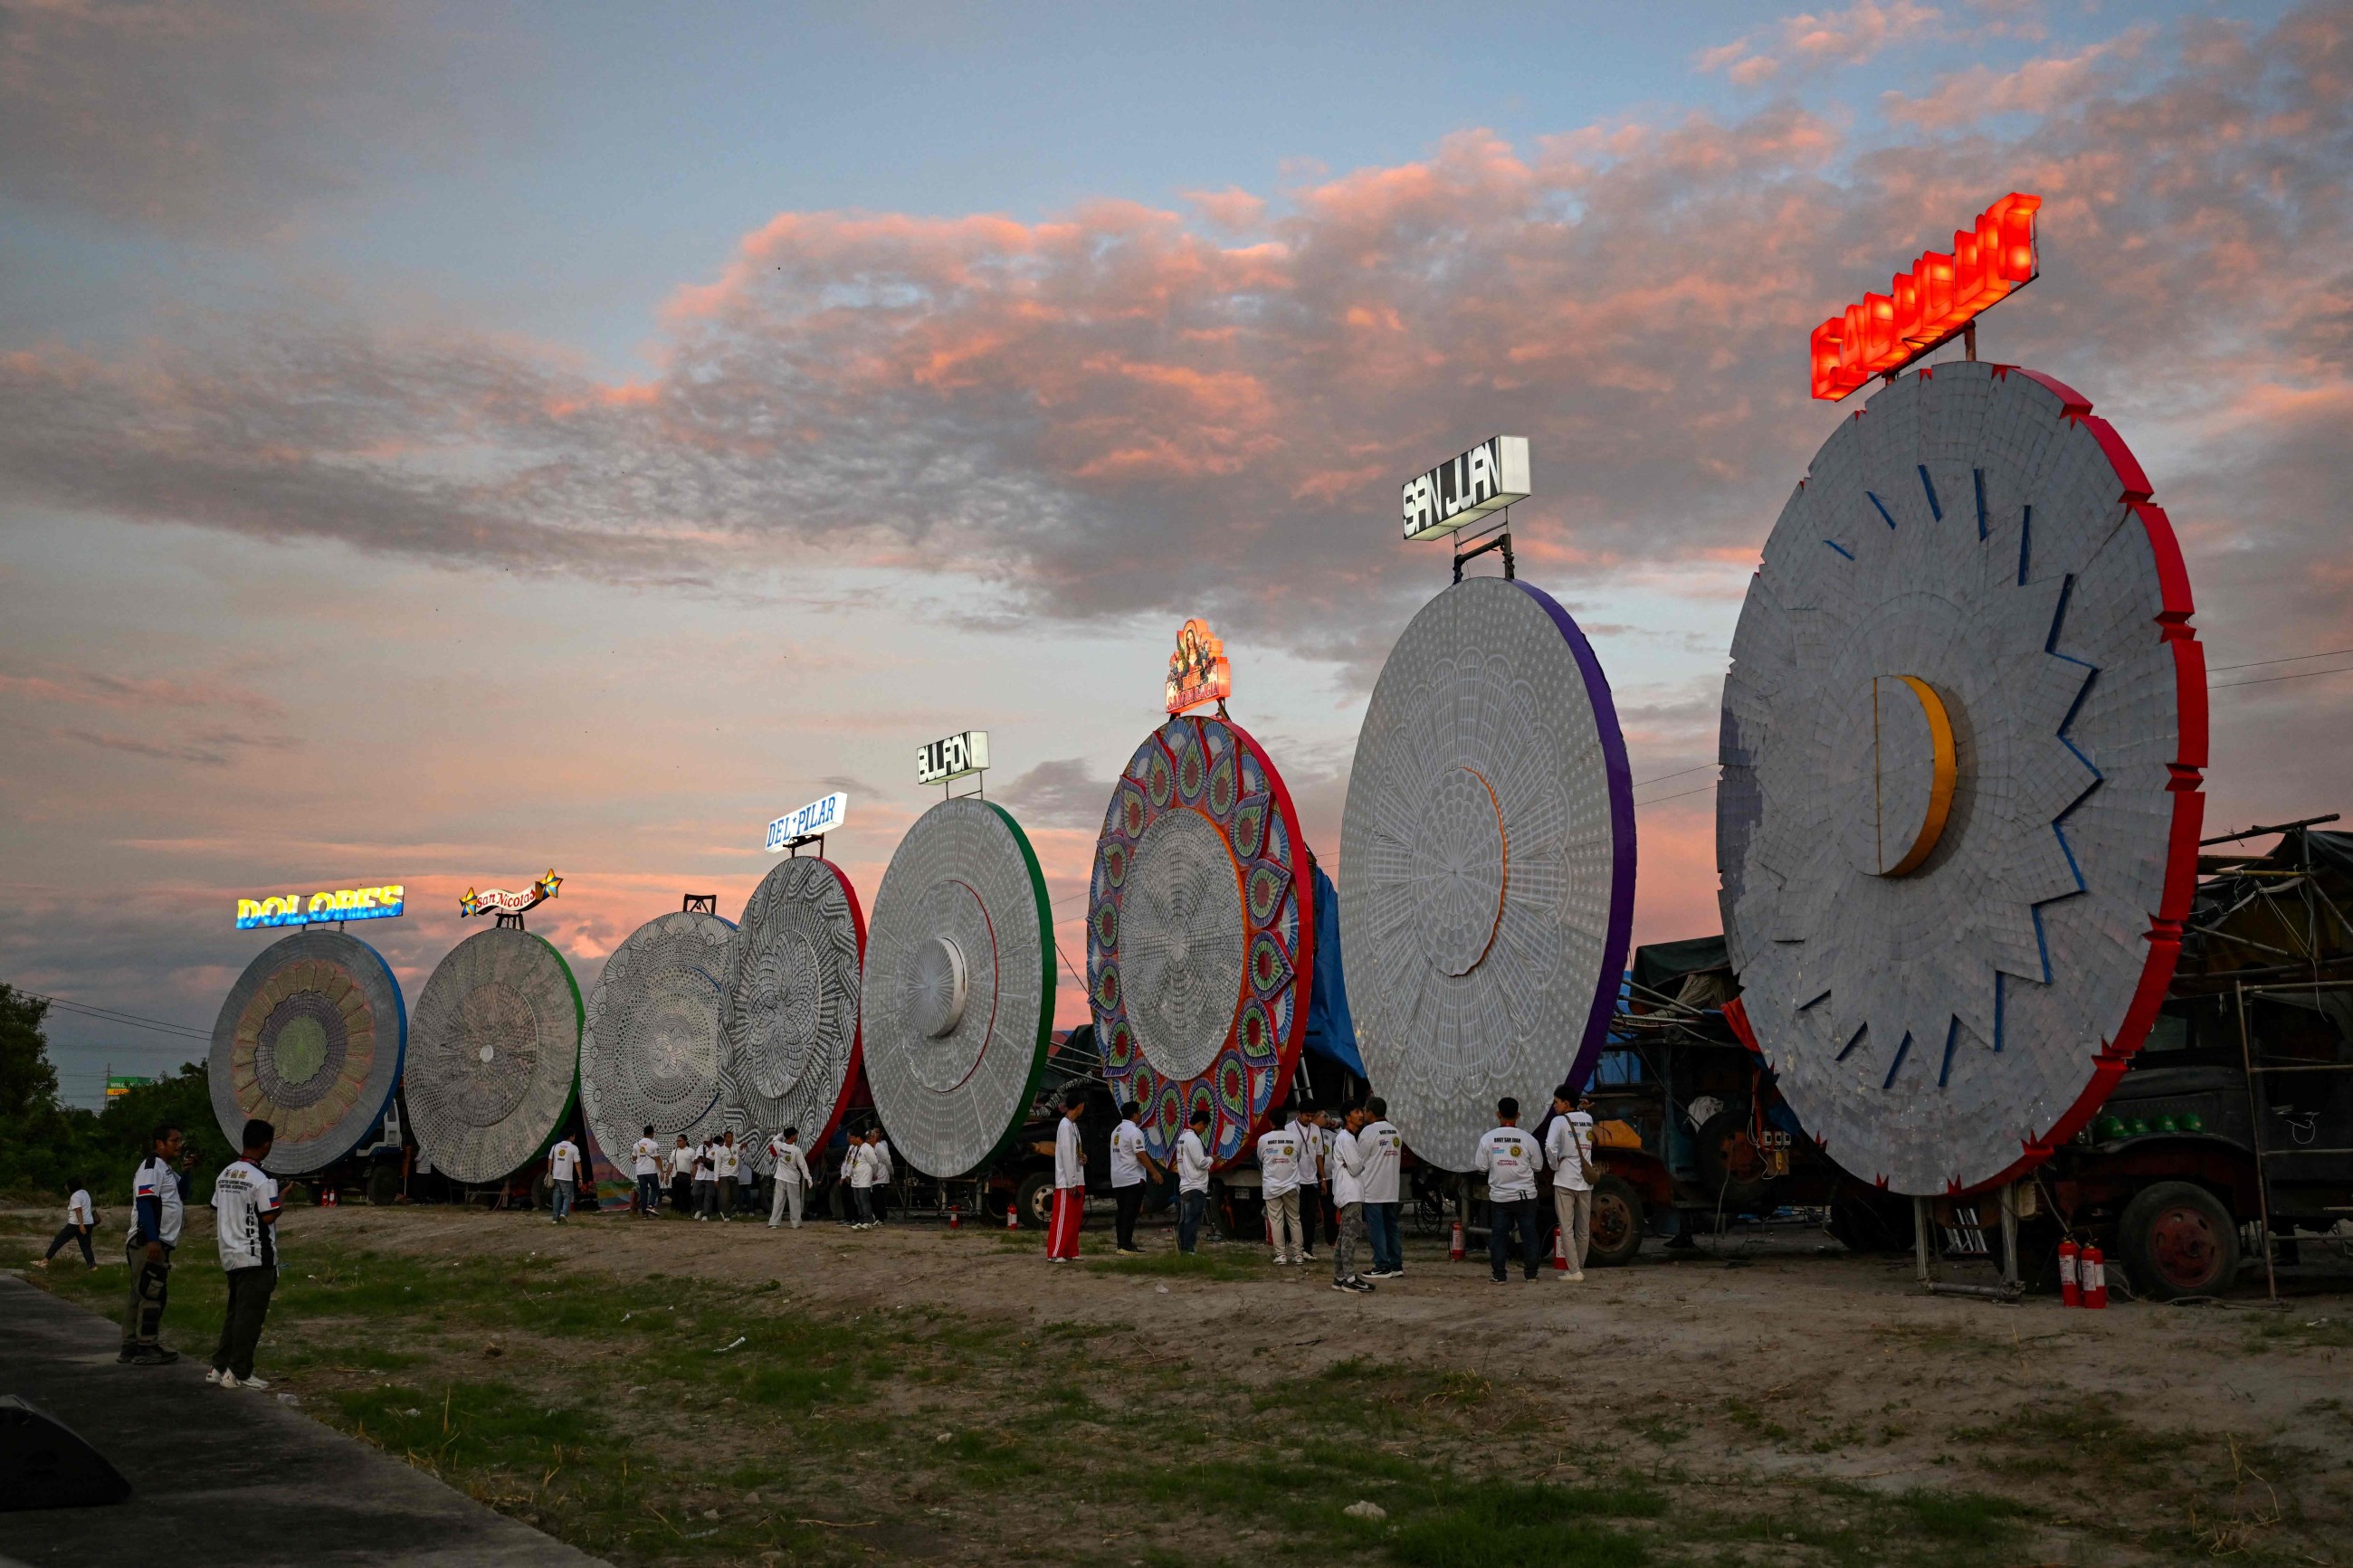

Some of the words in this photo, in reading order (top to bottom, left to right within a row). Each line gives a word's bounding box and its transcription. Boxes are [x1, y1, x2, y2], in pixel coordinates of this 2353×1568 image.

[1403, 467, 1443, 537] SAN
[1445, 436, 1500, 516] JUAN
[917, 731, 971, 784] BULAON
[767, 817, 791, 848] DEL
[796, 796, 836, 835] PILAR
[235, 885, 405, 930] DOLORES
[497, 889, 537, 908] Nicolas
